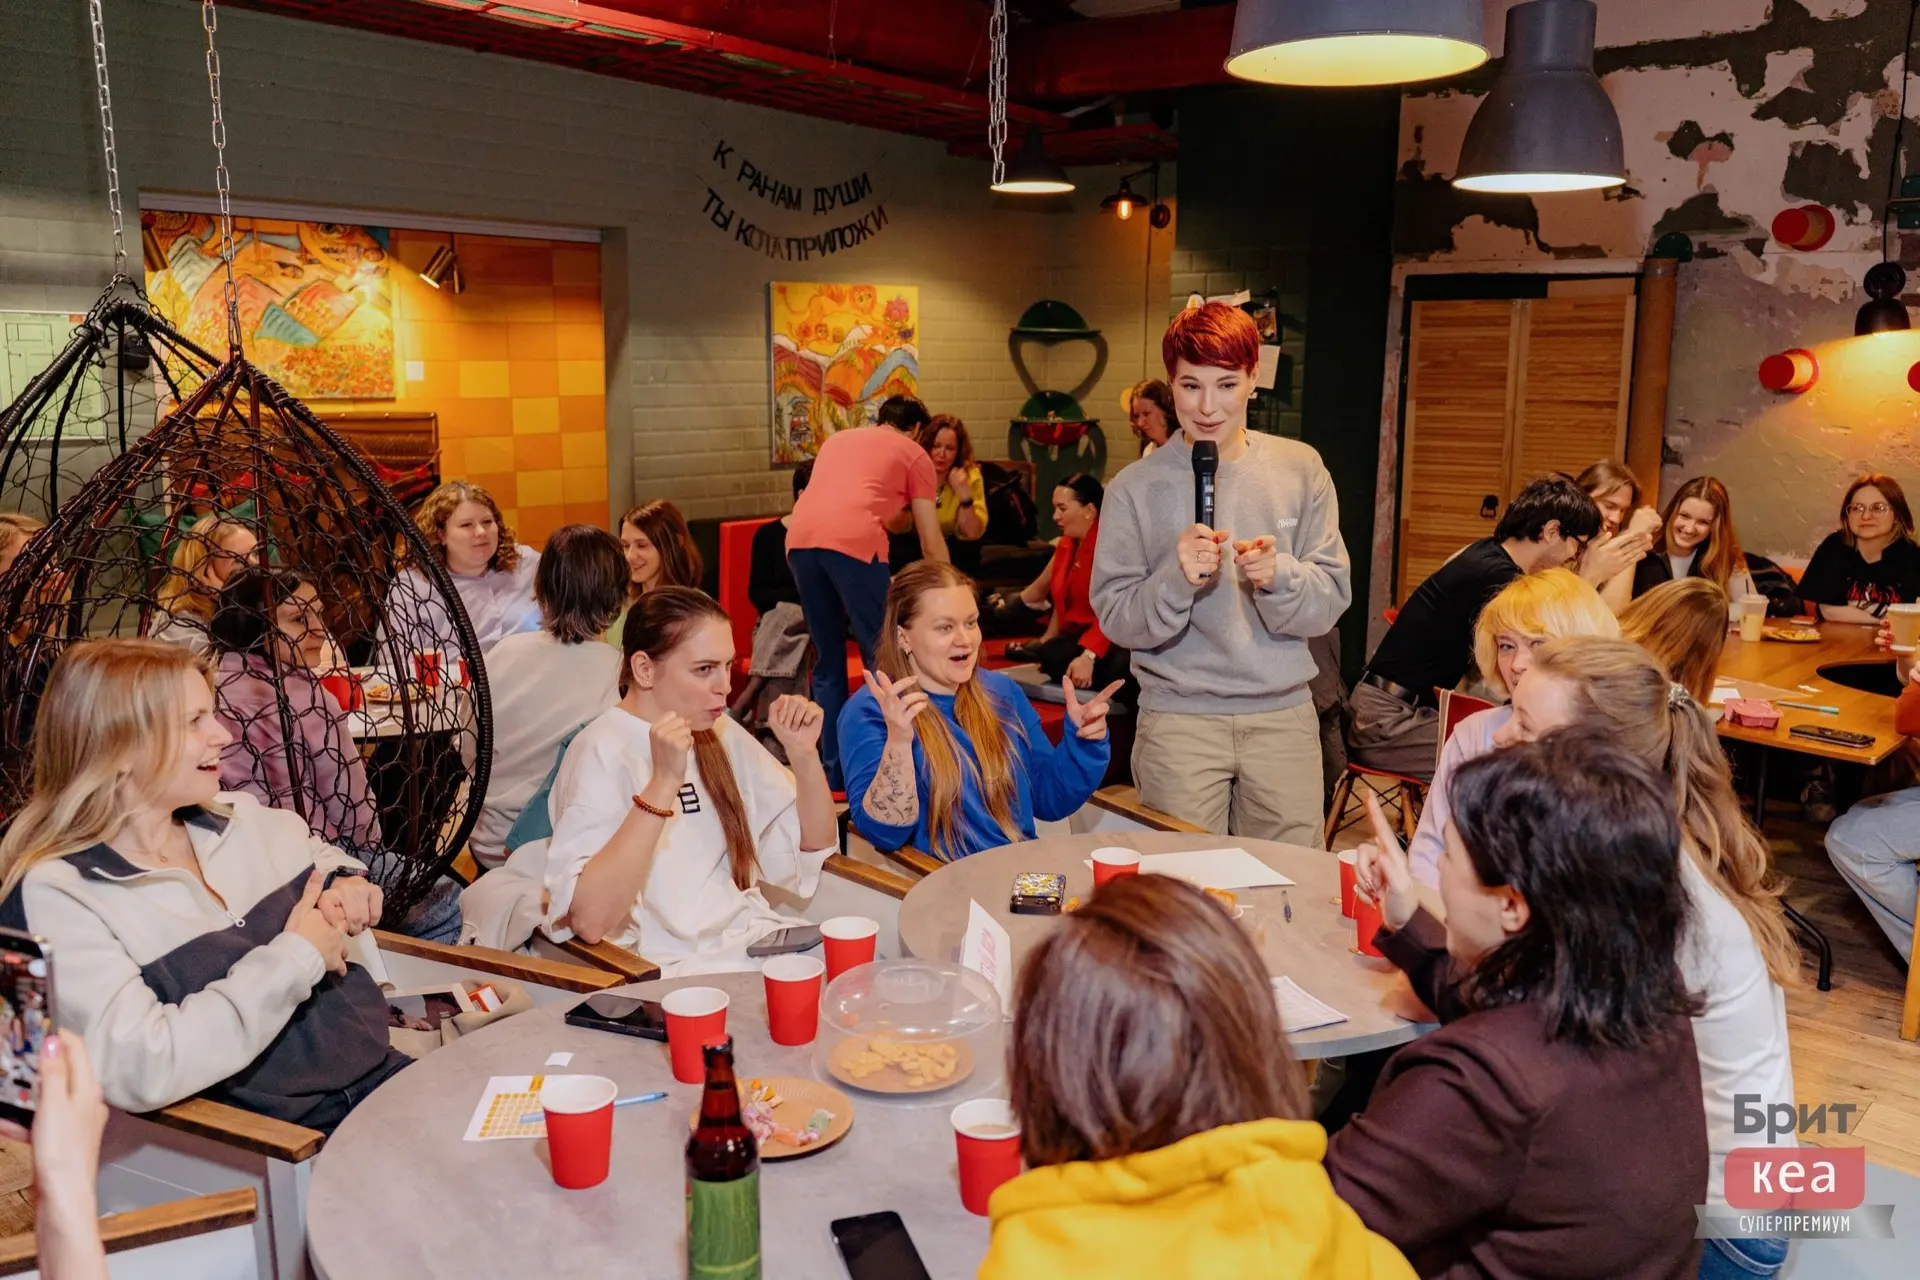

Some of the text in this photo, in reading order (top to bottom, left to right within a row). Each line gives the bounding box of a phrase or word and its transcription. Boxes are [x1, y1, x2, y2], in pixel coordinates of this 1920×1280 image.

[713, 140, 872, 215] К РАНАМ ДУШИ
[703, 188, 735, 231] ТЫ
